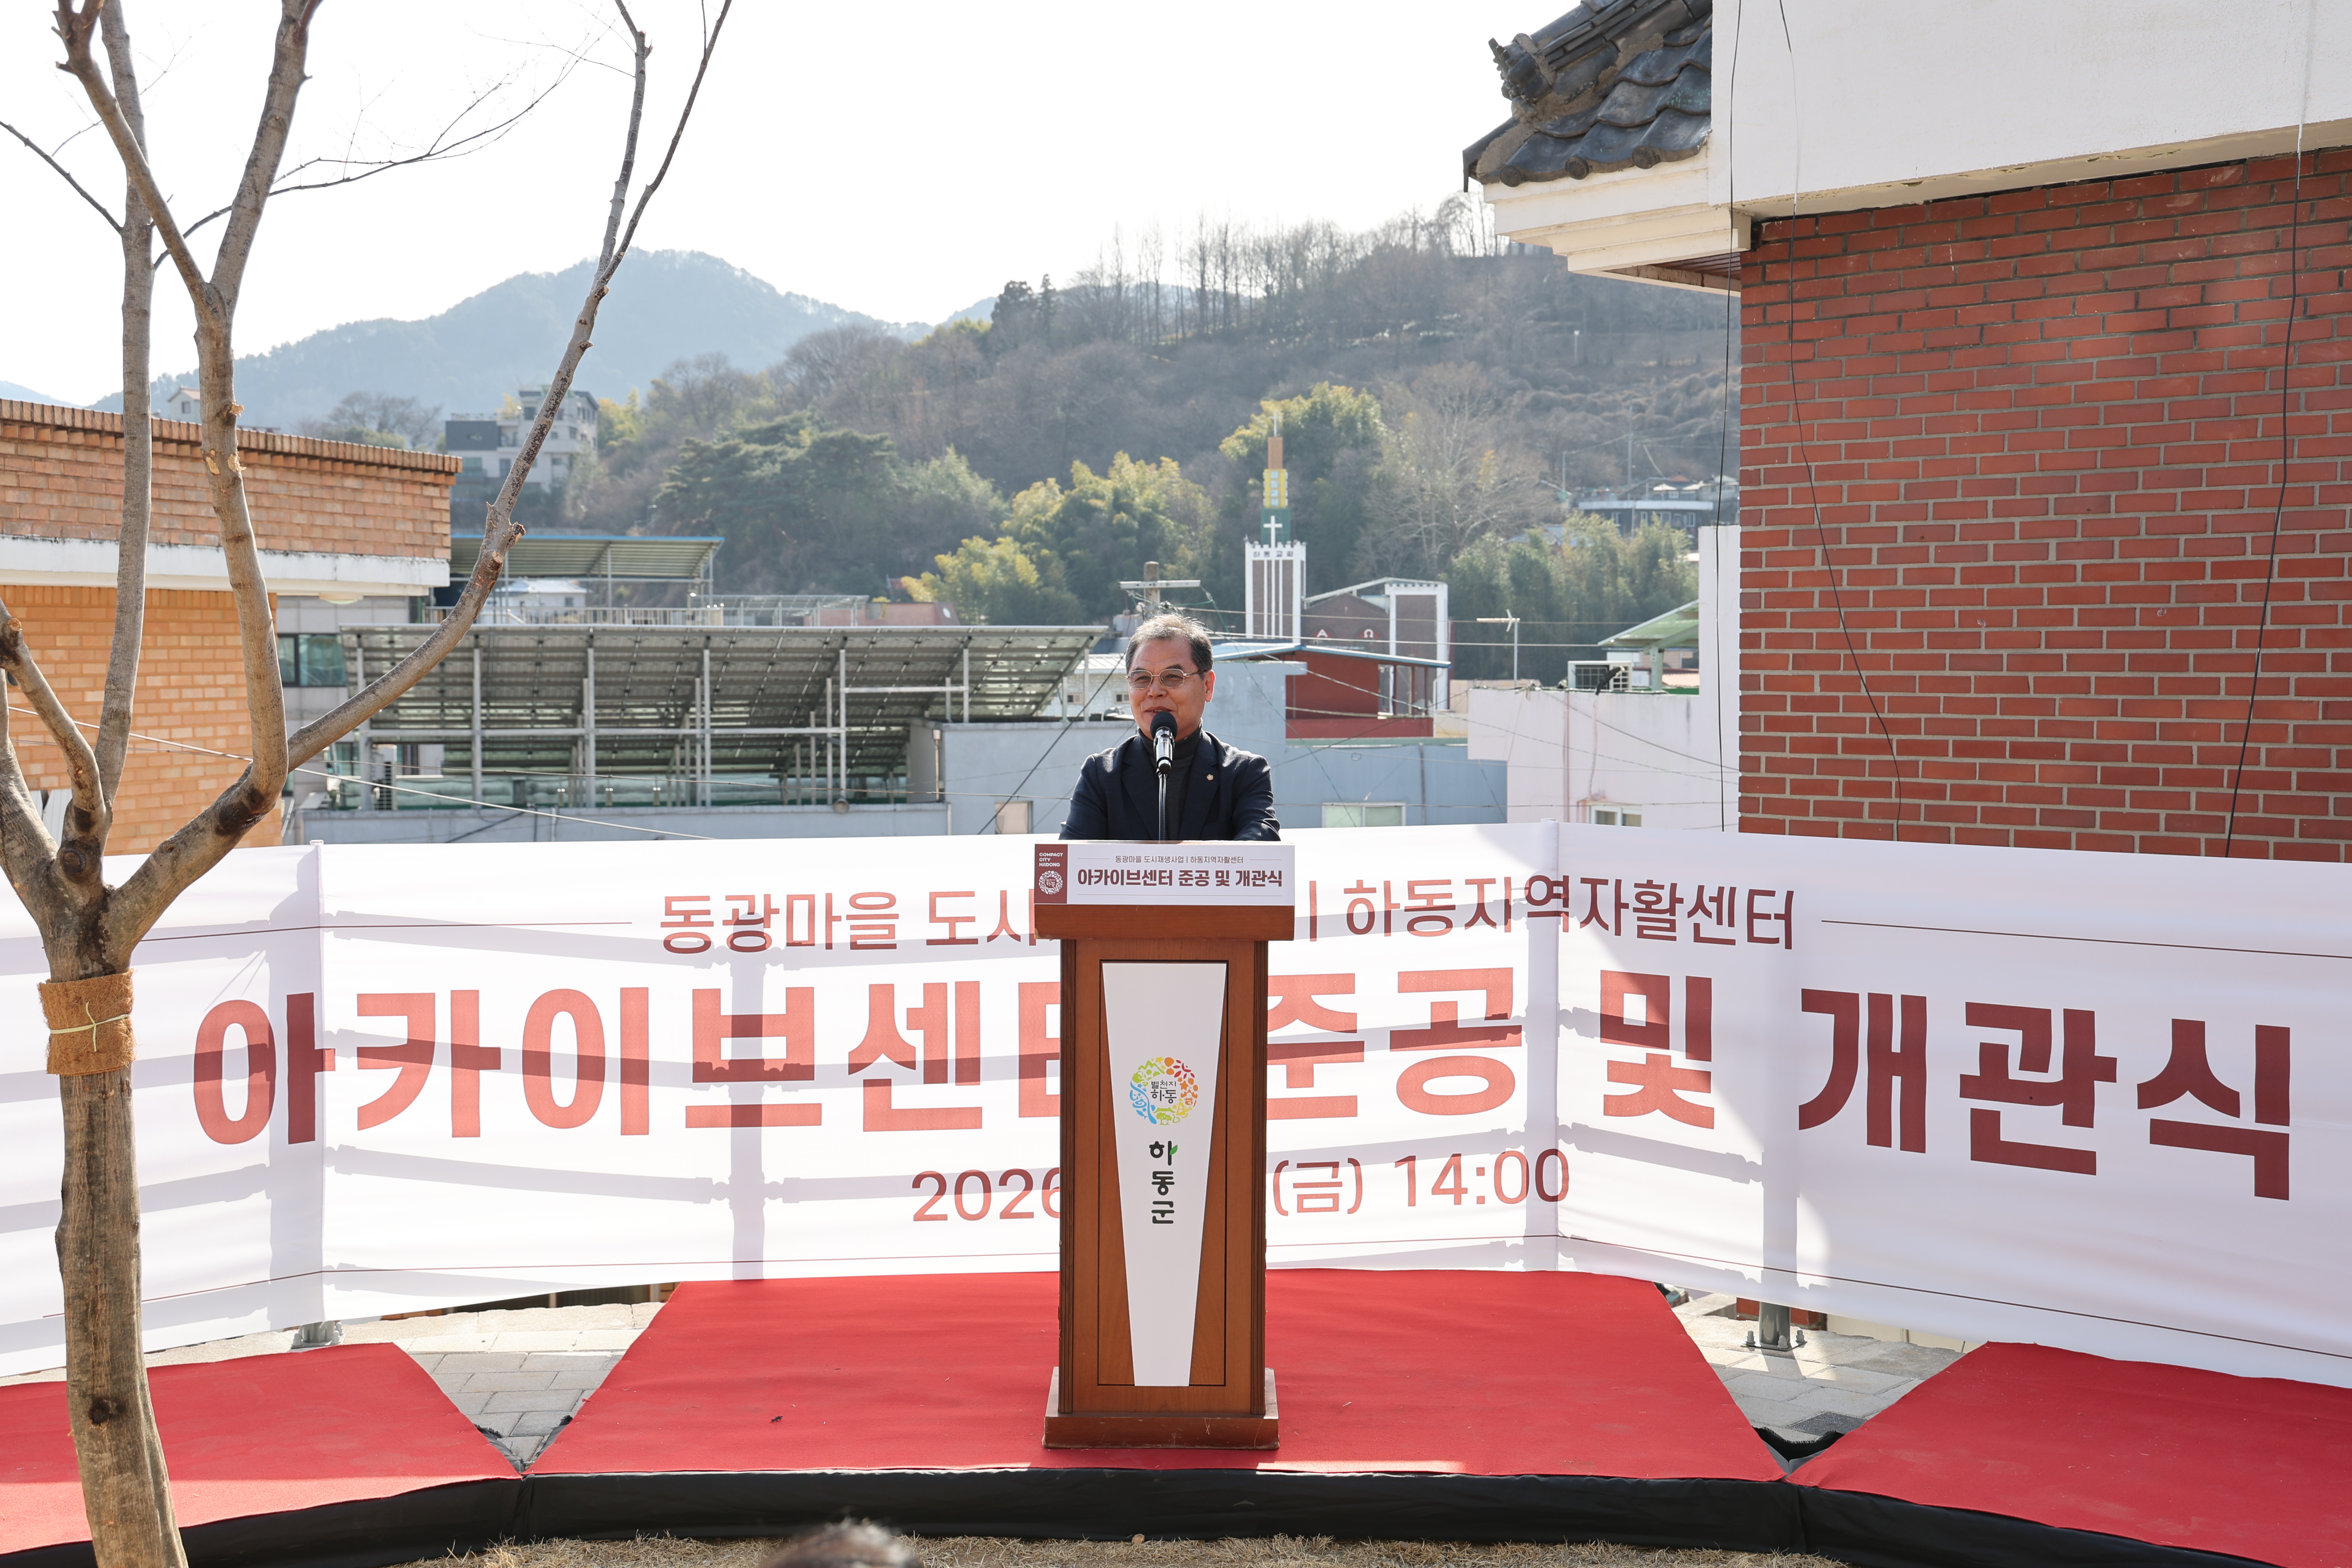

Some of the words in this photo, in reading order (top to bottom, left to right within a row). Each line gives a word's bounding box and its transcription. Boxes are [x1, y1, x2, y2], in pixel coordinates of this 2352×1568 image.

[1078, 869, 1173, 886] 아카이브센터
[1178, 870, 1210, 887] 준공
[1215, 870, 1230, 887] 및
[1235, 870, 1282, 887] 개관식
[1190, 856, 1243, 864] 하동지역자활센터
[660, 891, 899, 954] 동광마을
[926, 888, 1036, 946] 도시
[1343, 875, 1794, 950] 하동지역자활센터
[1151, 1080, 1176, 1089] 별천지
[1151, 1089, 1177, 1104] 하동
[1266, 967, 1523, 1120] 준공
[1600, 969, 1715, 1129] 및
[1798, 988, 2290, 1201] 개관식
[1149, 1140, 1178, 1224] 하동군
[1394, 1148, 1570, 1207] 14:00
